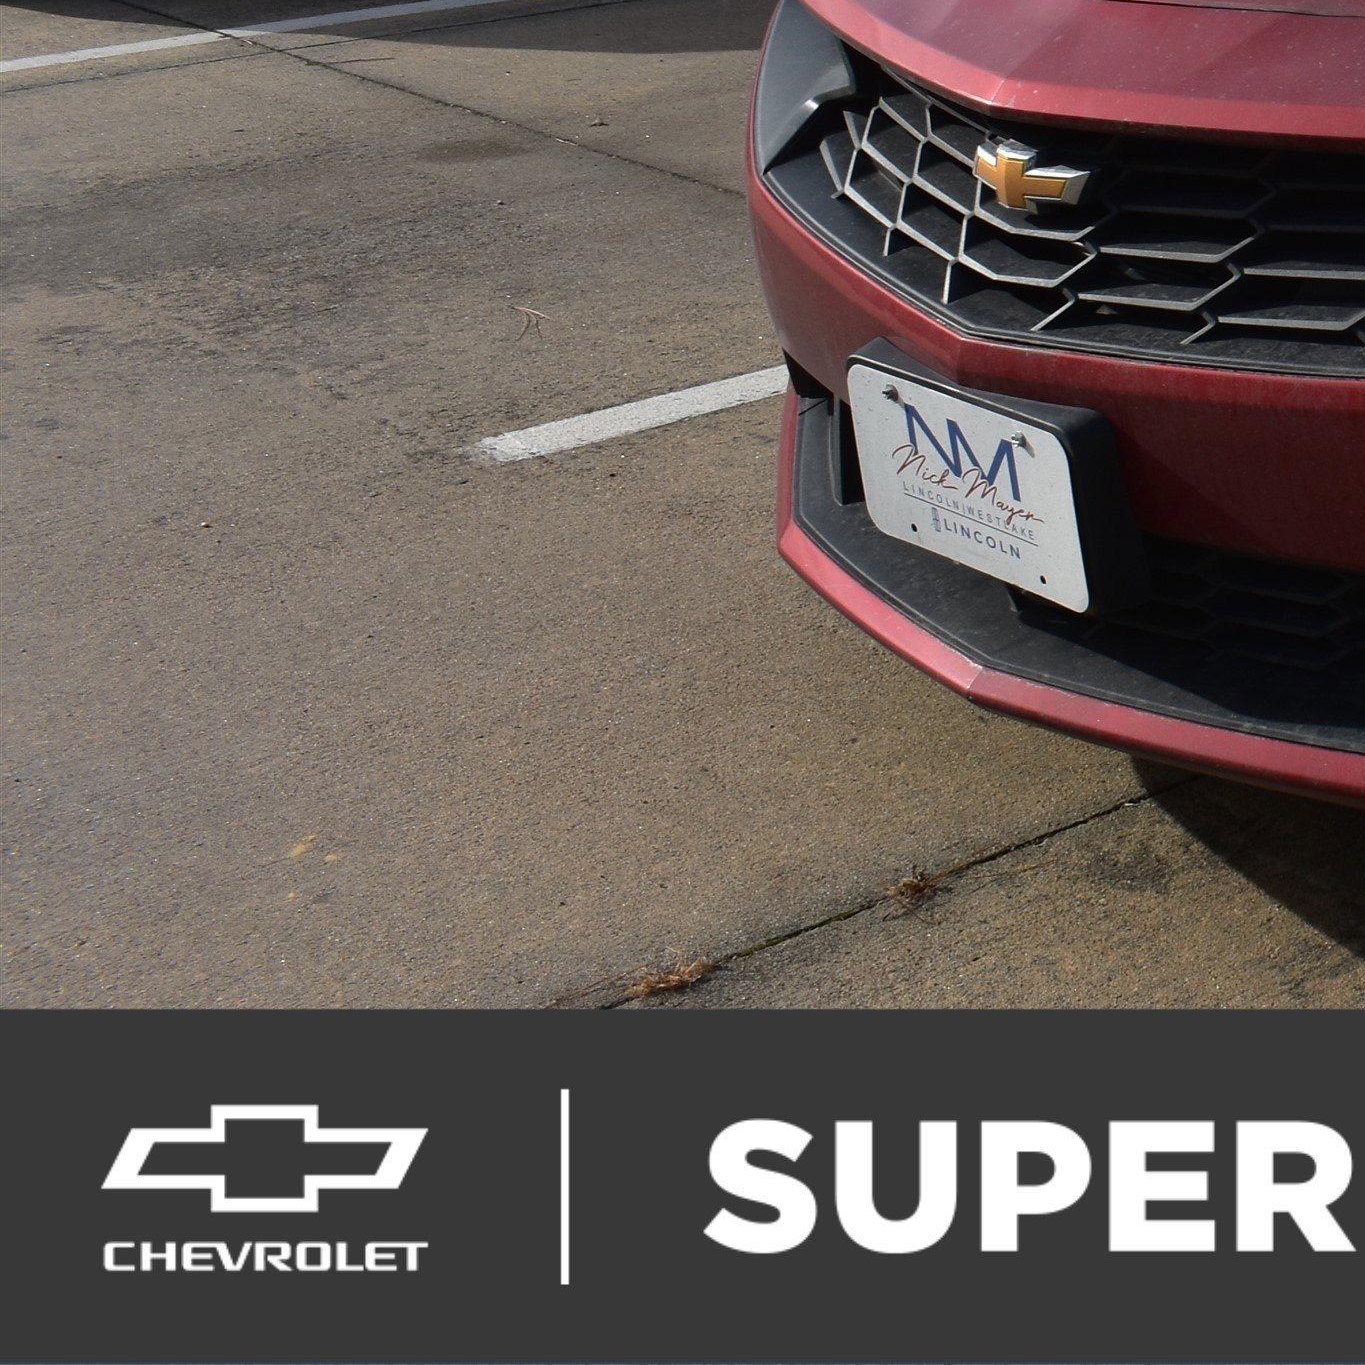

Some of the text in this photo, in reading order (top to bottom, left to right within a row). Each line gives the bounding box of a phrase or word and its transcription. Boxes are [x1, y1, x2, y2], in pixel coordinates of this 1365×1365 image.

[892, 444, 1044, 525] Nick Mayer
[944, 518, 1021, 559] LINCOLN
